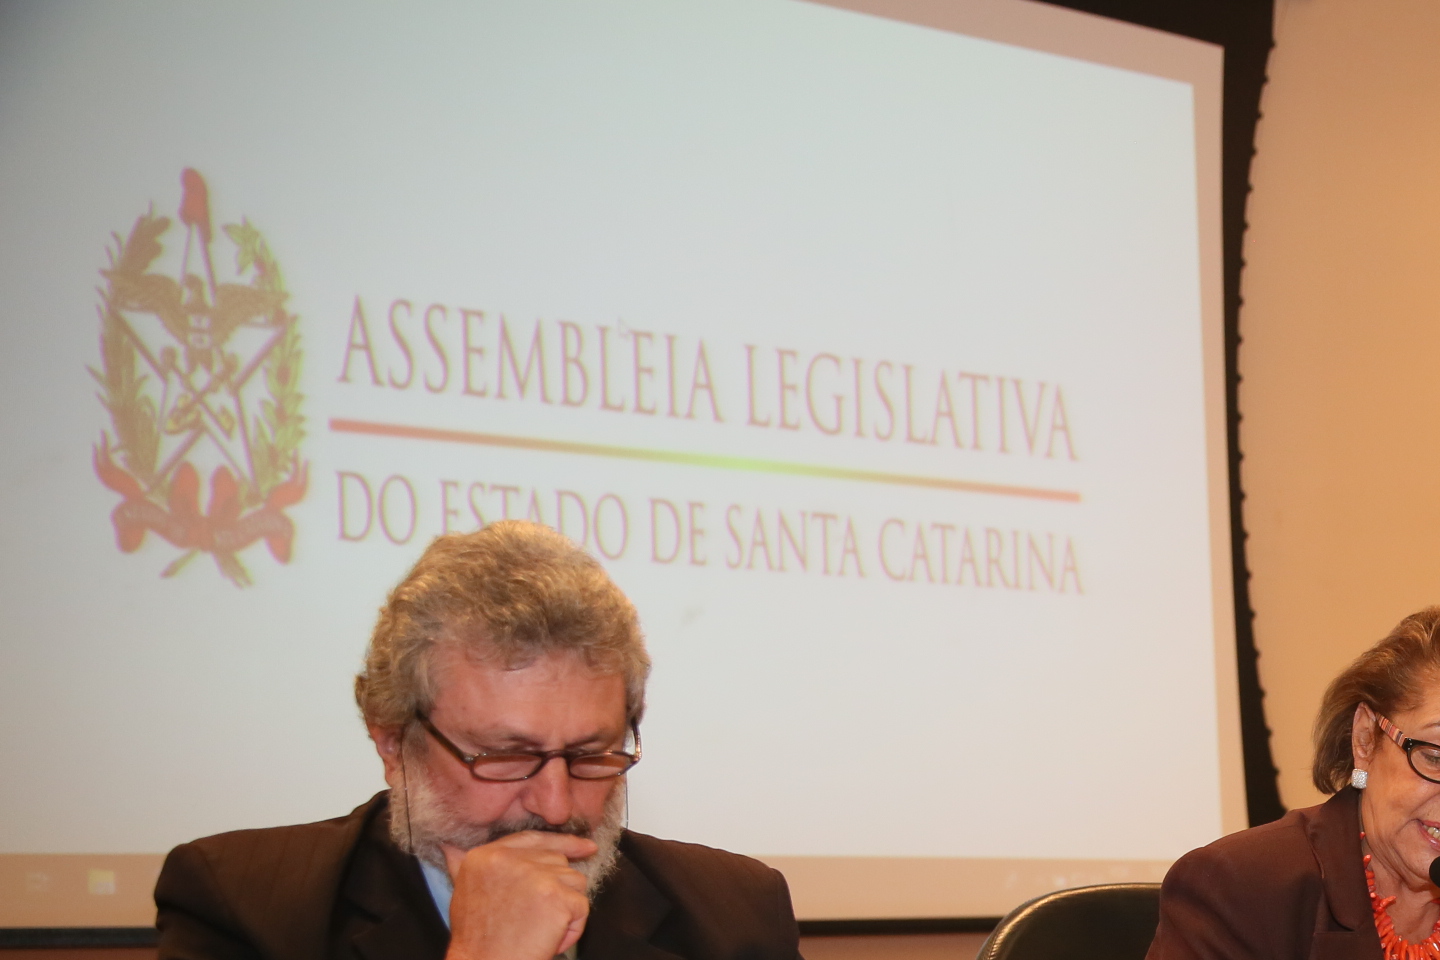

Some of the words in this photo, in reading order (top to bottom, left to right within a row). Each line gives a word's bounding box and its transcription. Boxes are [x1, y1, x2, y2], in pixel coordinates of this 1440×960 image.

[336, 294, 725, 424] ASSEMBLEIA
[743, 343, 1081, 462] LEGISLATIVA
[335, 470, 417, 546] DO
[648, 497, 707, 566] DE
[725, 503, 867, 580] SANTA
[877, 517, 1085, 595] CATARINA
